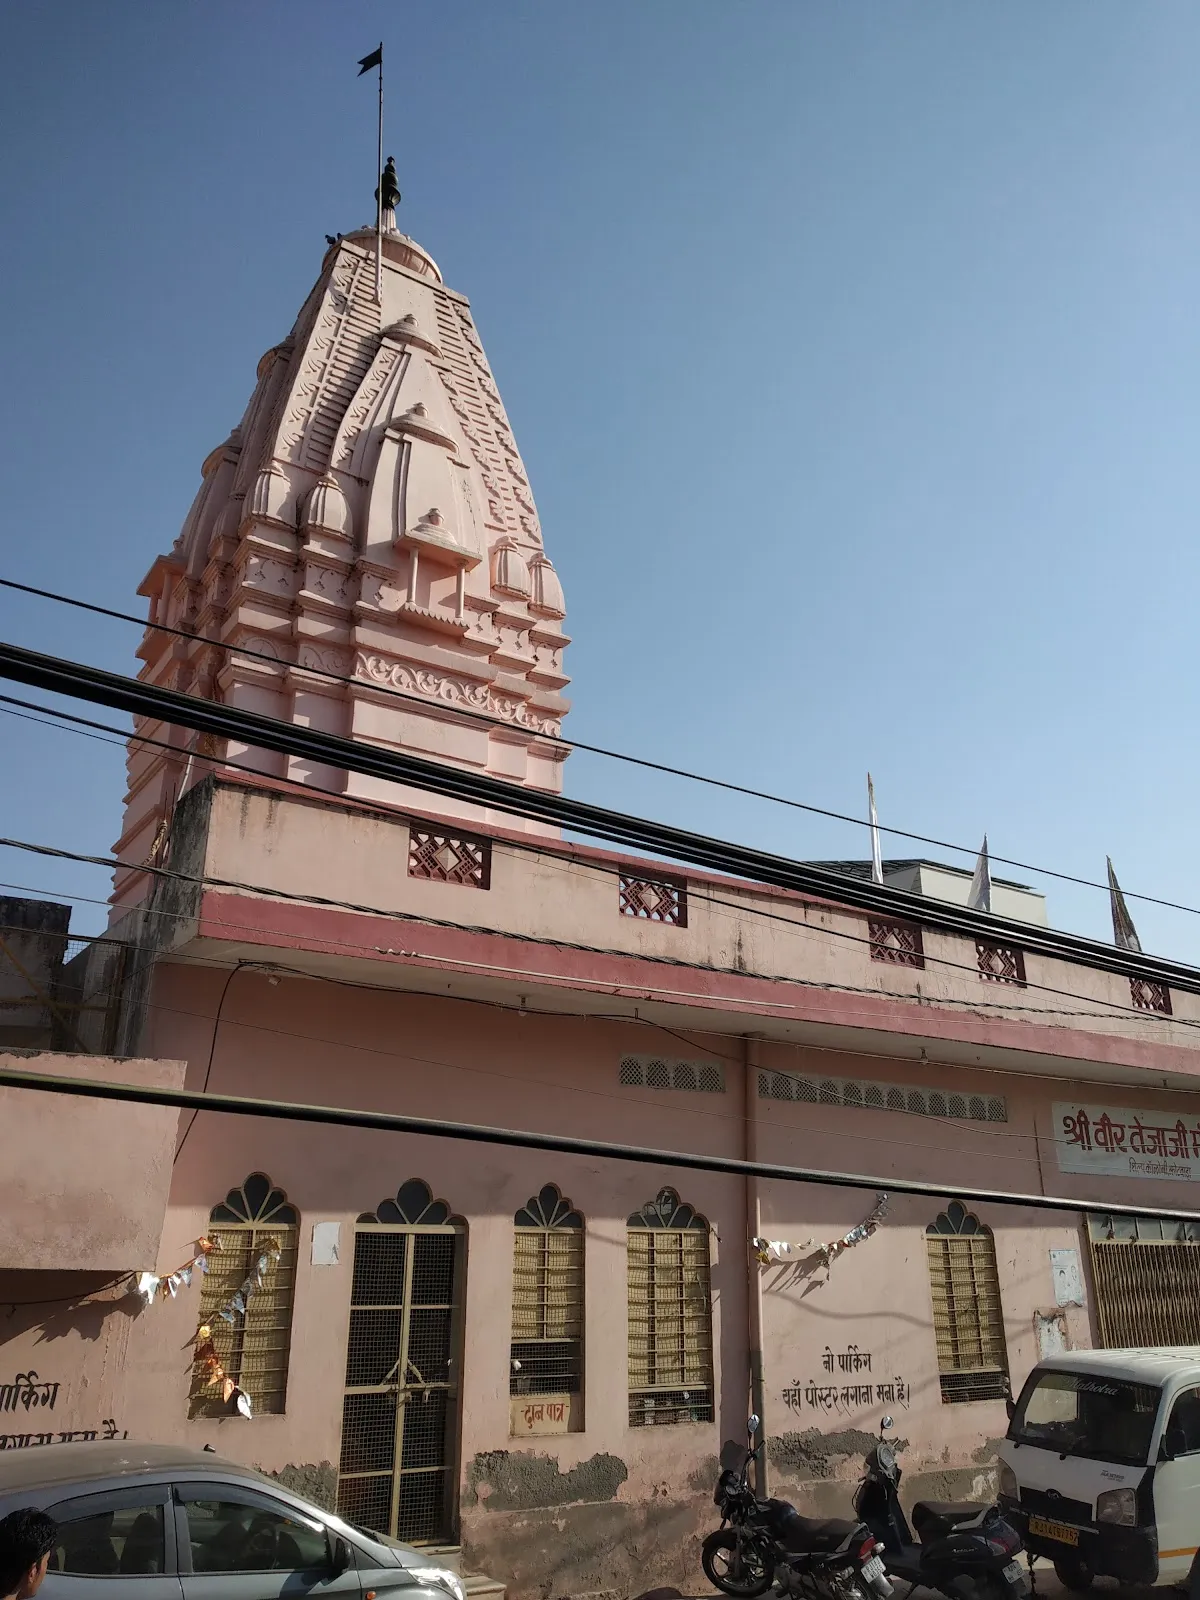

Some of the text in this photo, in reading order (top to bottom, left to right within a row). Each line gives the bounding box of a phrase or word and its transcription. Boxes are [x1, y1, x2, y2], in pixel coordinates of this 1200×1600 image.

[1062, 1108, 1092, 1151] श्री
[1092, 1112, 1128, 1153] वीर
[1128, 1116, 1190, 1159] तेजाजी
[822, 1346, 834, 1373] नो
[781, 1379, 801, 1417] यहाँ
[804, 1379, 841, 1417] पोस्टर
[841, 1385, 873, 1417] लगाना
[876, 1384, 895, 1404] मना
